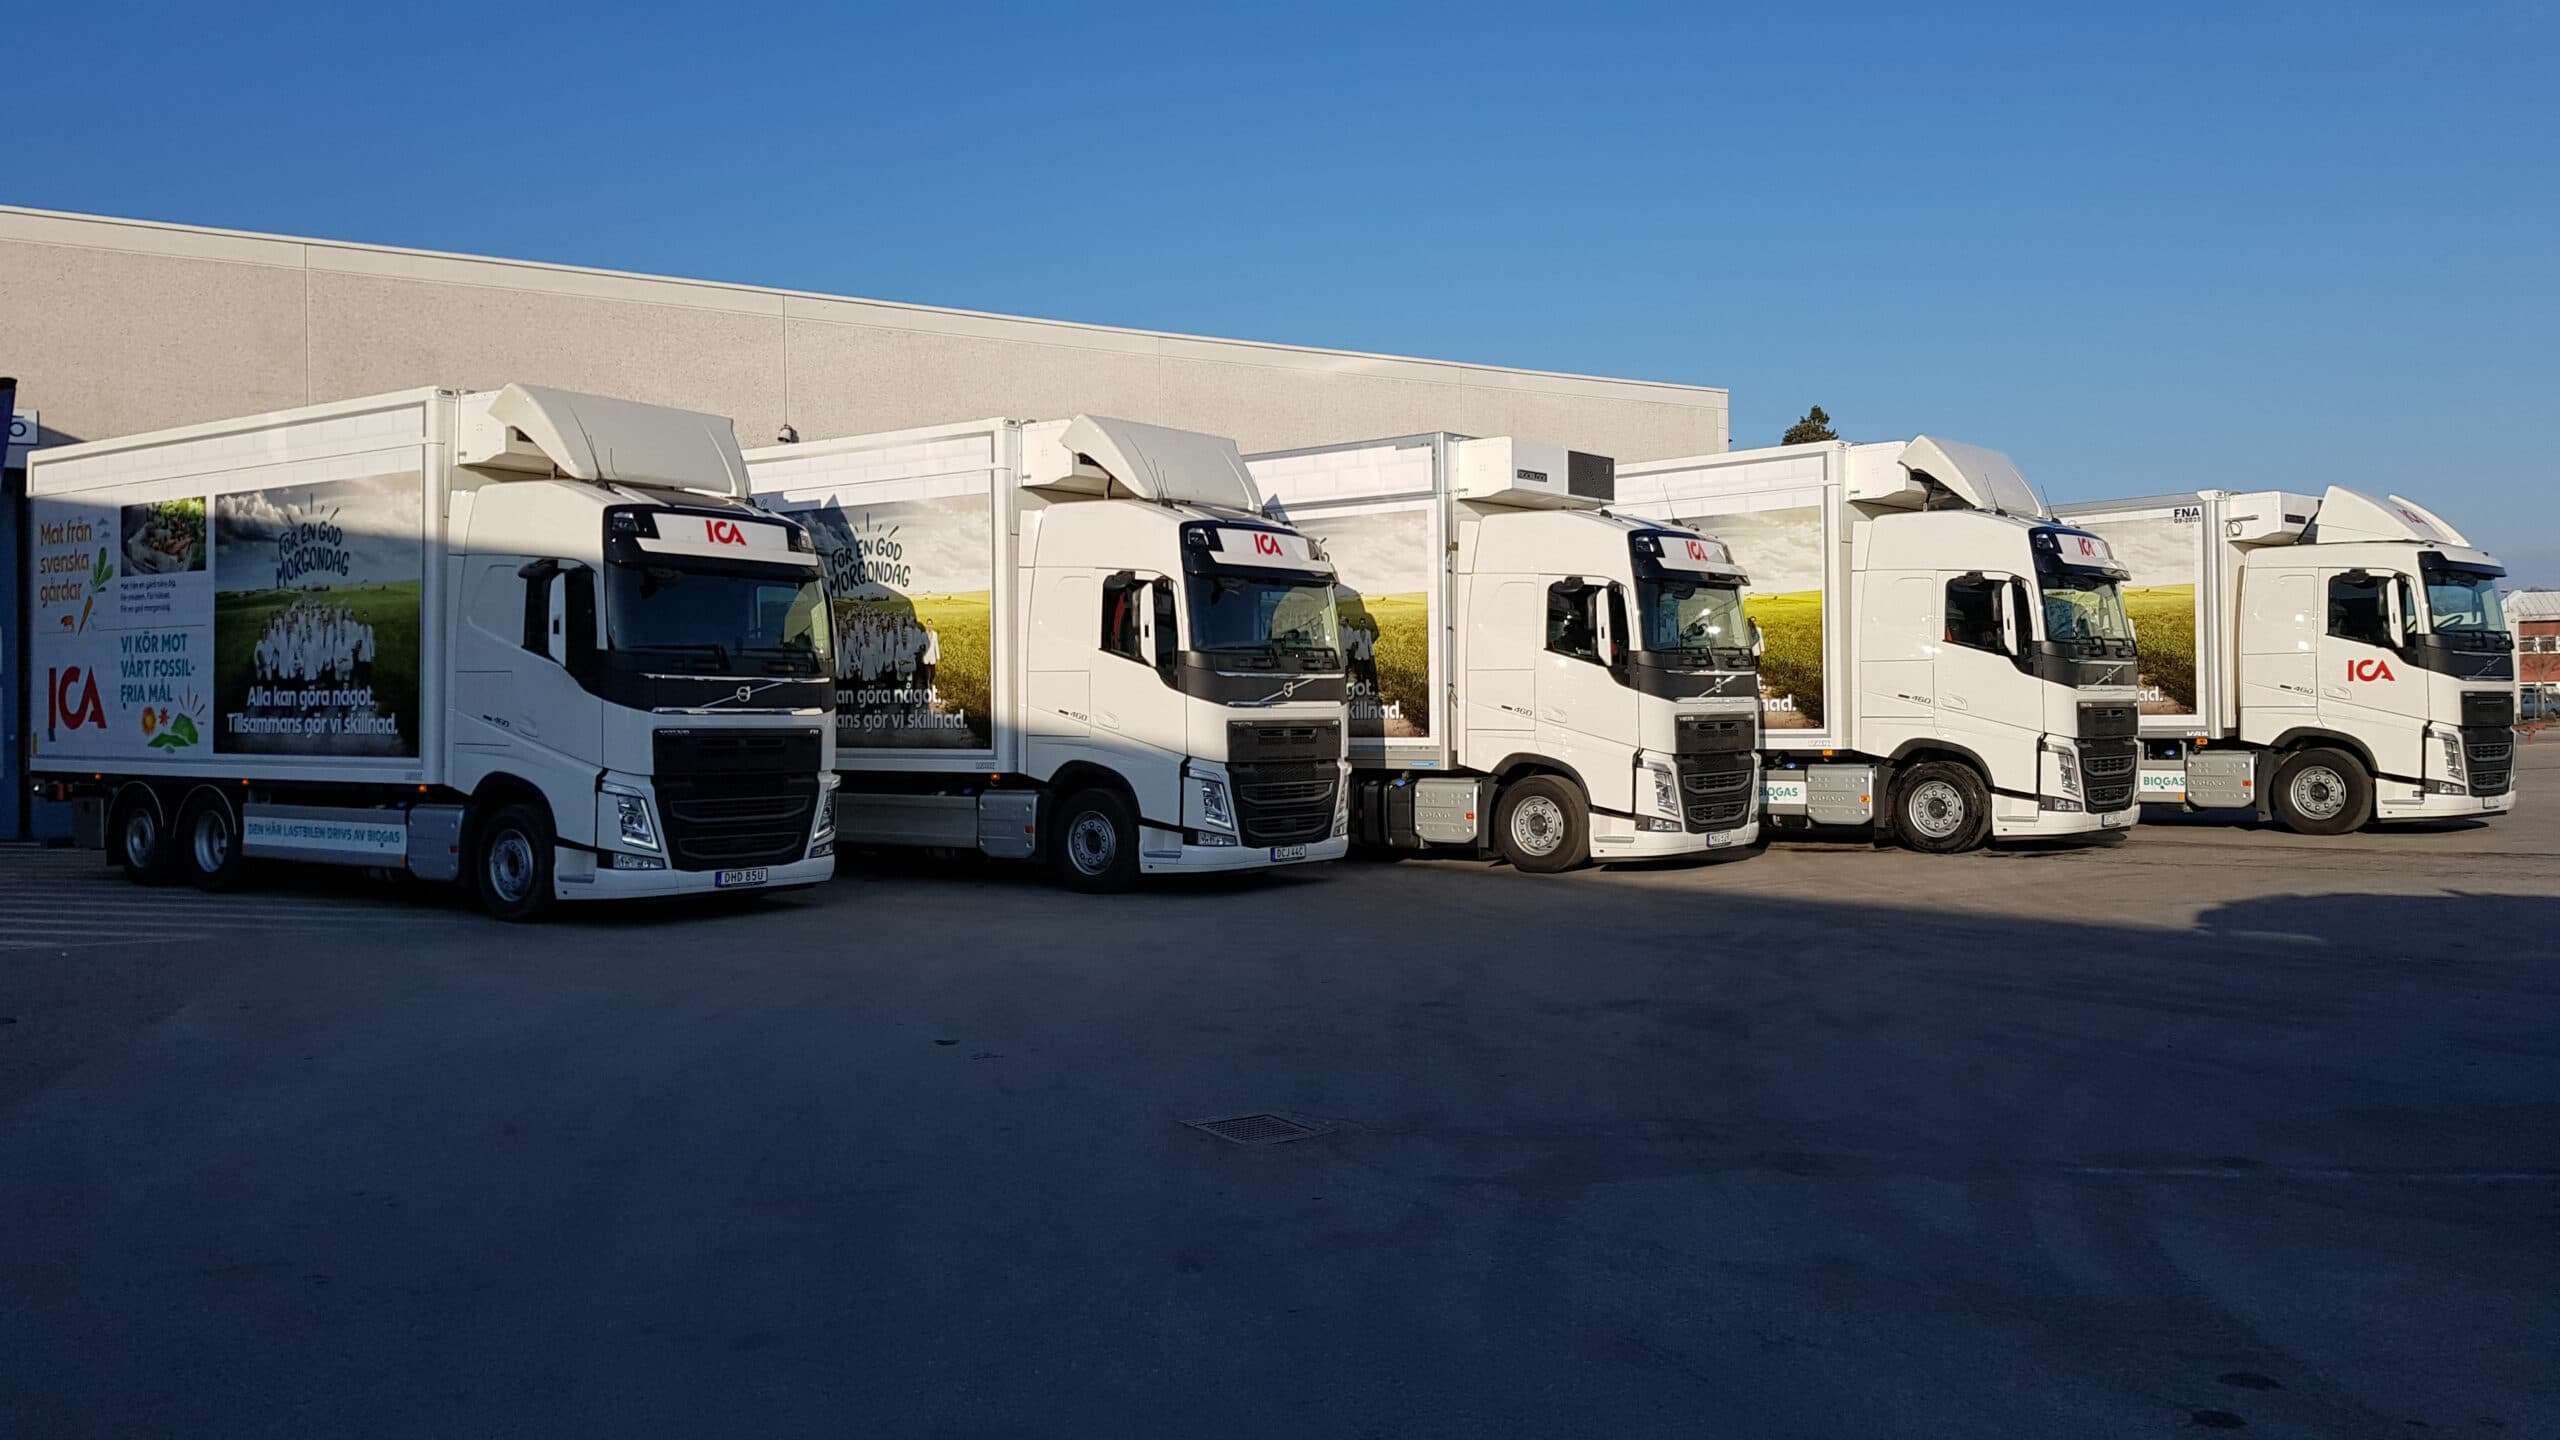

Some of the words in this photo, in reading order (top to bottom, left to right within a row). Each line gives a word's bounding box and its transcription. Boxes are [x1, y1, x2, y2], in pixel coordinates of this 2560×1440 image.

[2173, 507, 2200, 518] FNA
[41, 523, 64, 546] Mat
[67, 517, 92, 543] från
[278, 531, 298, 560] FÖR
[301, 522, 317, 544] EN
[319, 520, 342, 547] GOD
[705, 519, 747, 546] ICA
[832, 547, 853, 573] FÖR
[856, 539, 873, 558] EN
[876, 537, 902, 561] GOD
[1253, 532, 1283, 557] ICA
[1685, 540, 1708, 561] ICA
[2077, 536, 2096, 557] ICA
[40, 547, 89, 574] svenska
[276, 546, 350, 589] MORGONDAG
[829, 561, 911, 599] MORGONDAG
[41, 577, 82, 608] gårdar
[121, 636, 133, 653] VI
[135, 631, 159, 653] KÖR
[162, 634, 188, 652] MOT
[121, 655, 150, 678] VÅRT
[153, 658, 195, 677] FOSSIL-
[2347, 659, 2396, 682] ICA
[48, 665, 107, 731] ICA
[120, 684, 145, 703] FRIA
[149, 678, 173, 702] MÅL
[247, 686, 271, 706] Alla
[273, 685, 296, 706] kan
[300, 685, 330, 711] göra
[332, 683, 375, 711] något.
[836, 689, 854, 704] an
[857, 685, 890, 708] göra
[894, 682, 942, 708] något.
[1346, 679, 1376, 700] got.
[1911, 695, 1932, 705] 460
[864, 709, 887, 732] gör
[891, 710, 905, 728] vi
[907, 708, 968, 729] skillnad.
[1070, 711, 1088, 721] 460
[1349, 700, 1404, 719] killnad.
[1513, 707, 1533, 717] 460
[227, 712, 301, 734] Tillsammans
[305, 713, 327, 737] gör
[330, 714, 342, 733] vi
[344, 712, 398, 734] skillnad.
[1759, 787, 1798, 797] BIOGAS
[2143, 776, 2186, 787] BIOGAS
[248, 823, 264, 836] DEN
[265, 821, 281, 837] HÄR
[283, 825, 325, 840] LASTBILEN
[327, 827, 352, 840] DRIVS
[354, 829, 365, 841] AV
[367, 830, 400, 843] BIOGAS
[724, 871, 743, 883] DHD
